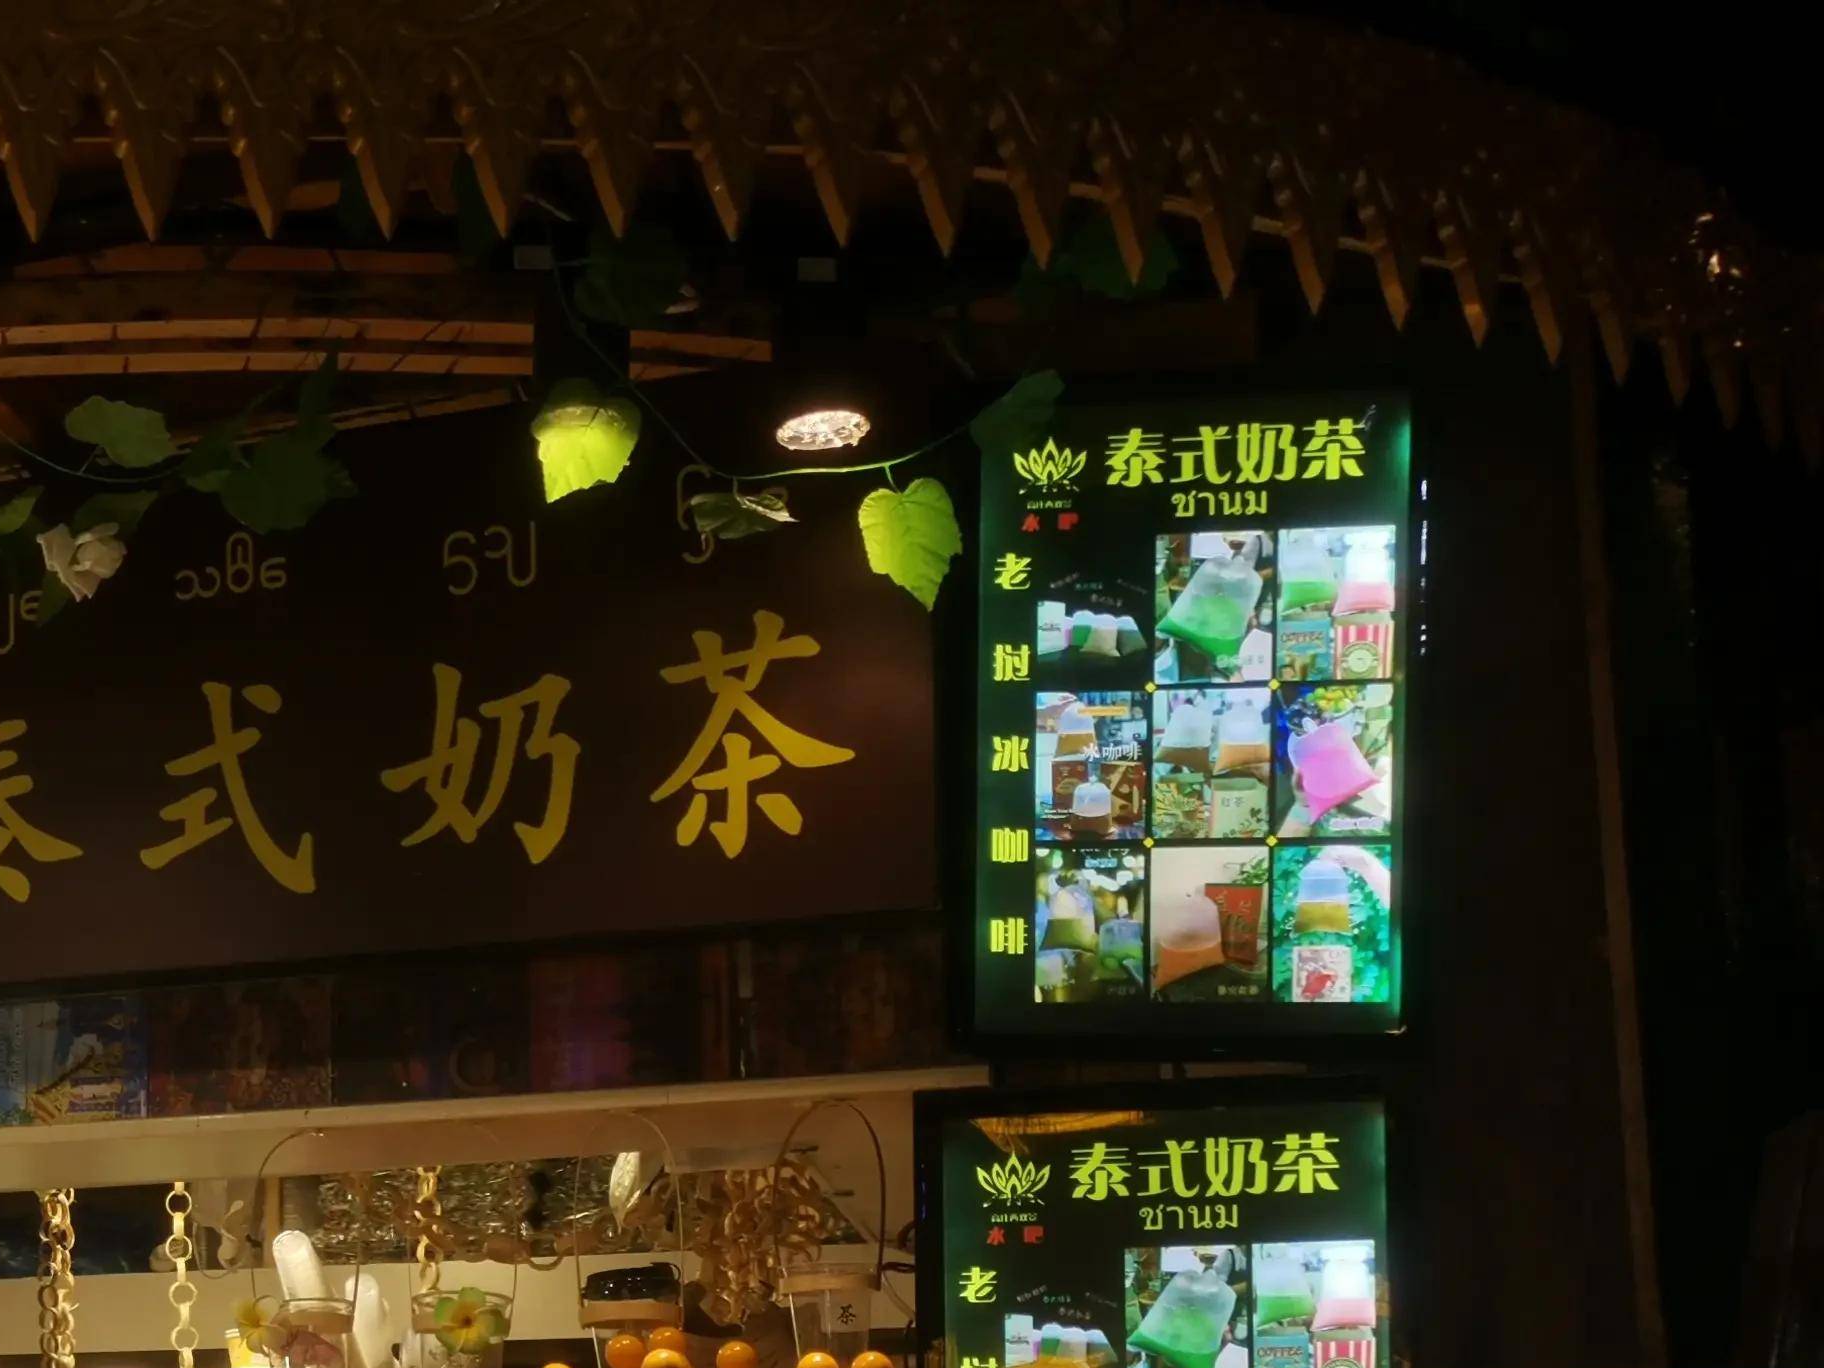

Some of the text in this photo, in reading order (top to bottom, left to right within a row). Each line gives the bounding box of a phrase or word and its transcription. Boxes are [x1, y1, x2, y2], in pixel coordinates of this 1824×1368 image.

[1104, 418, 1366, 488] 泰式奶茶
[1170, 486, 1269, 519] ชานม
[989, 552, 1033, 956] 老挝冰咖啡
[1069, 1132, 1341, 1199] 泰式奶茶
[1139, 1202, 1239, 1232] ชานม
